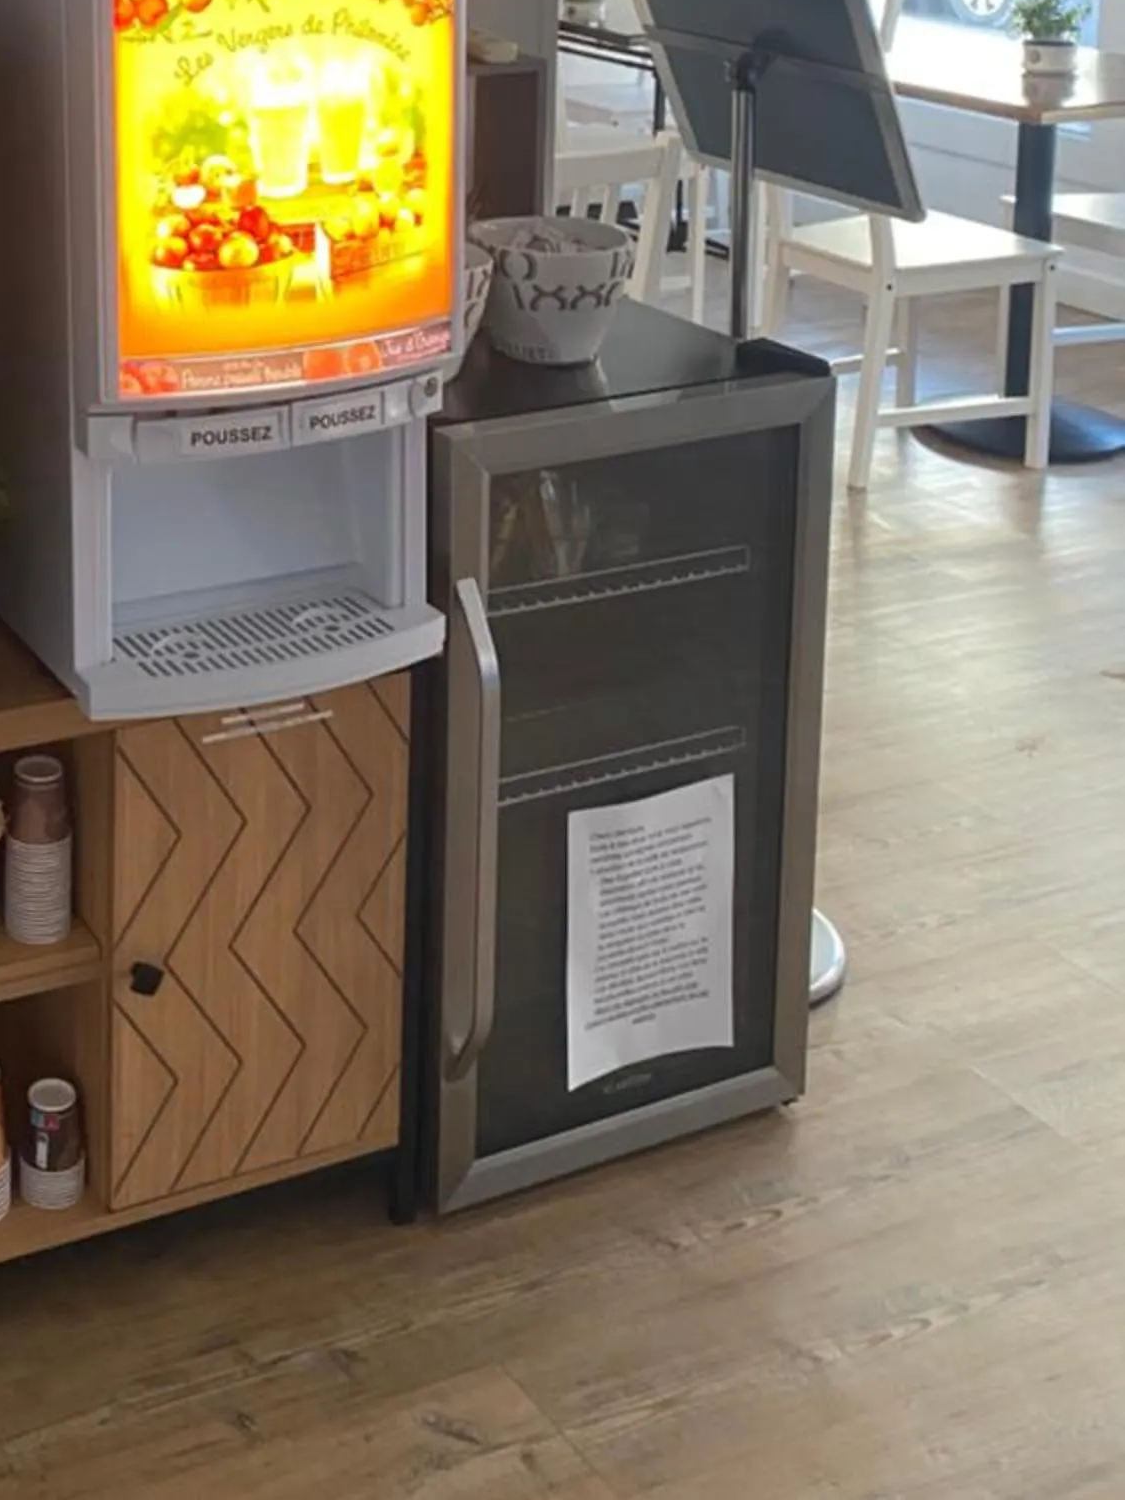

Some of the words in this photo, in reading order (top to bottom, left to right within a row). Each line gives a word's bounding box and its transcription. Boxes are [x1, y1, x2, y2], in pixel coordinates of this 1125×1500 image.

[173, 52, 215, 86] Les
[216, 22, 293, 54] Vergers
[300, 13, 325, 35] de
[309, 405, 376, 430] POUSSEZ
[190, 426, 273, 447] POUSSEZ
